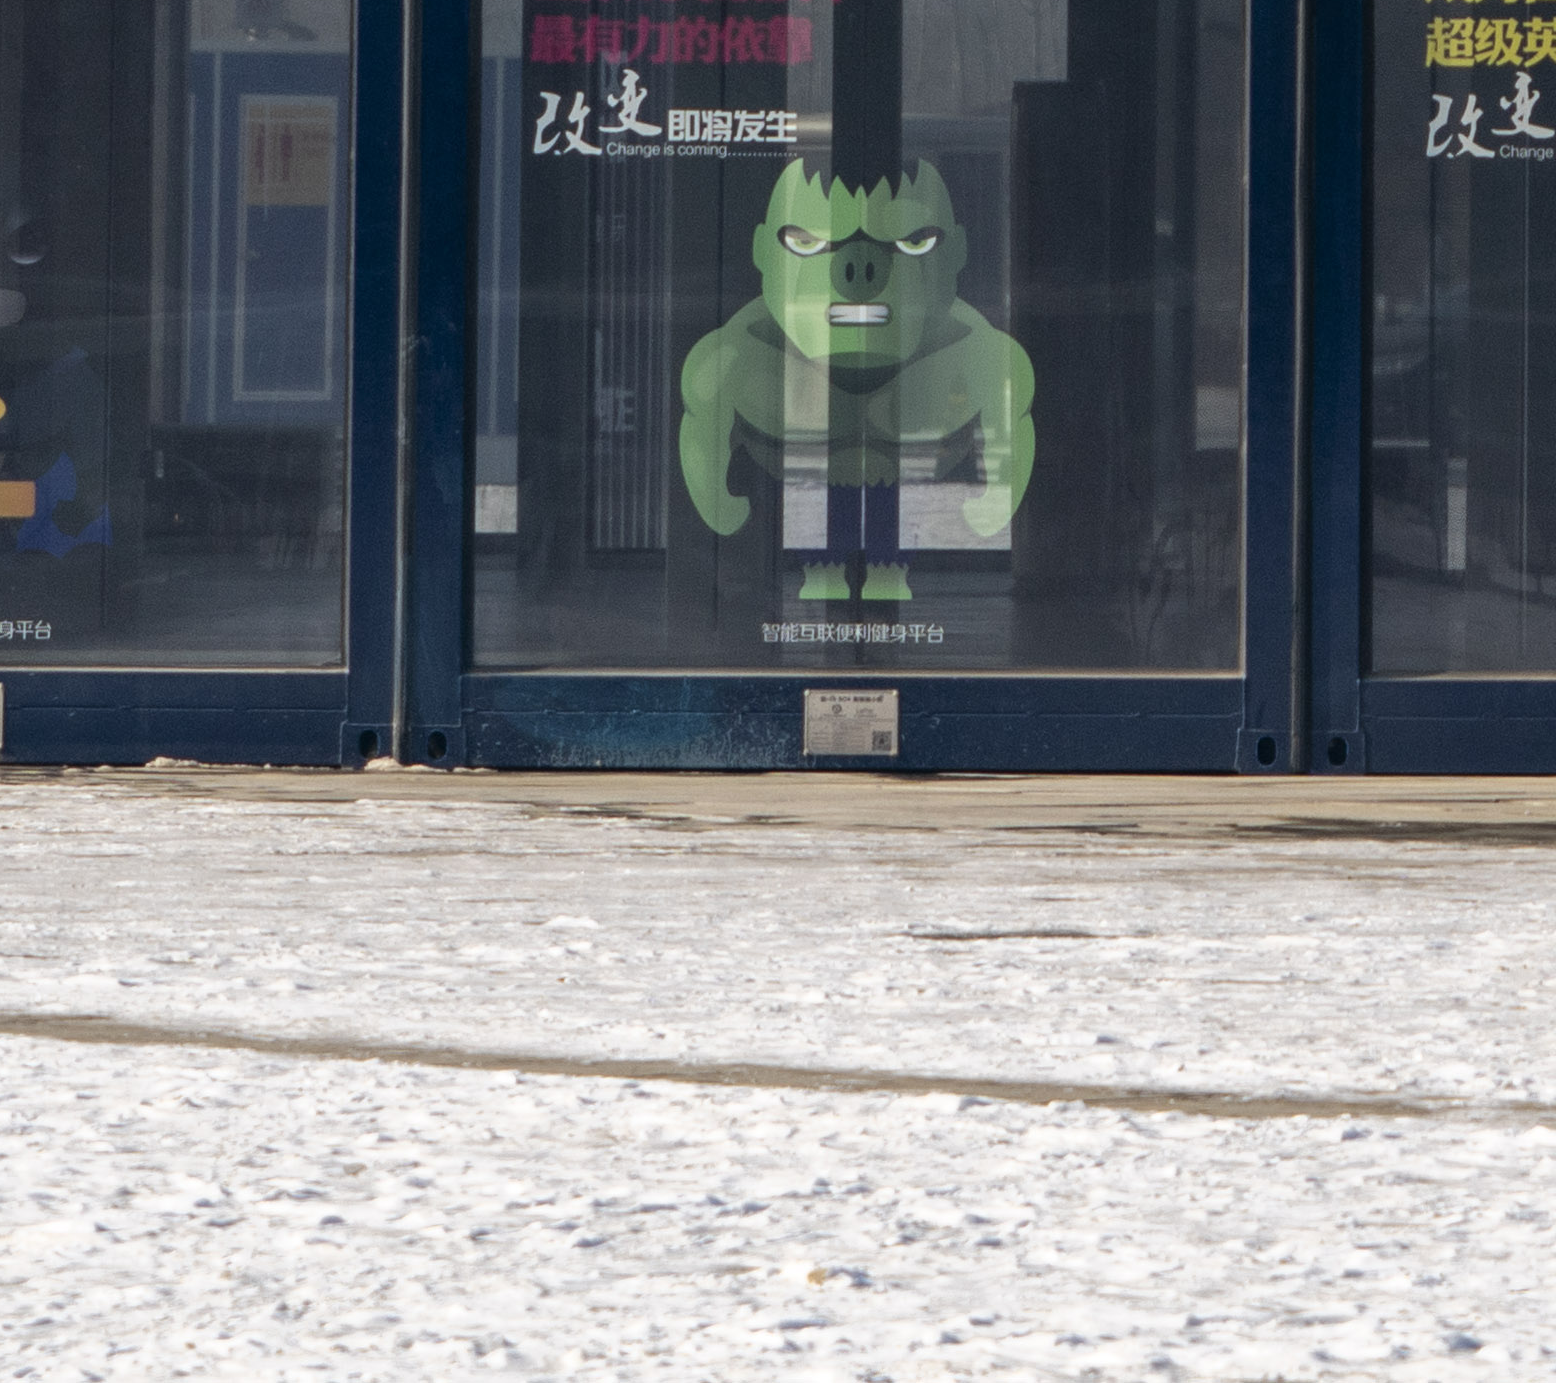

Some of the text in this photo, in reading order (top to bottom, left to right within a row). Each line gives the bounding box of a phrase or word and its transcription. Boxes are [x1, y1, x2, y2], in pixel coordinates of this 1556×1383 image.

[530, 16, 813, 64] 最有力的依靠
[606, 142, 661, 158] Change
[663, 142, 674, 155] is
[1500, 144, 1554, 160] Change
[762, 622, 945, 644] 智能互联便利健身平台
